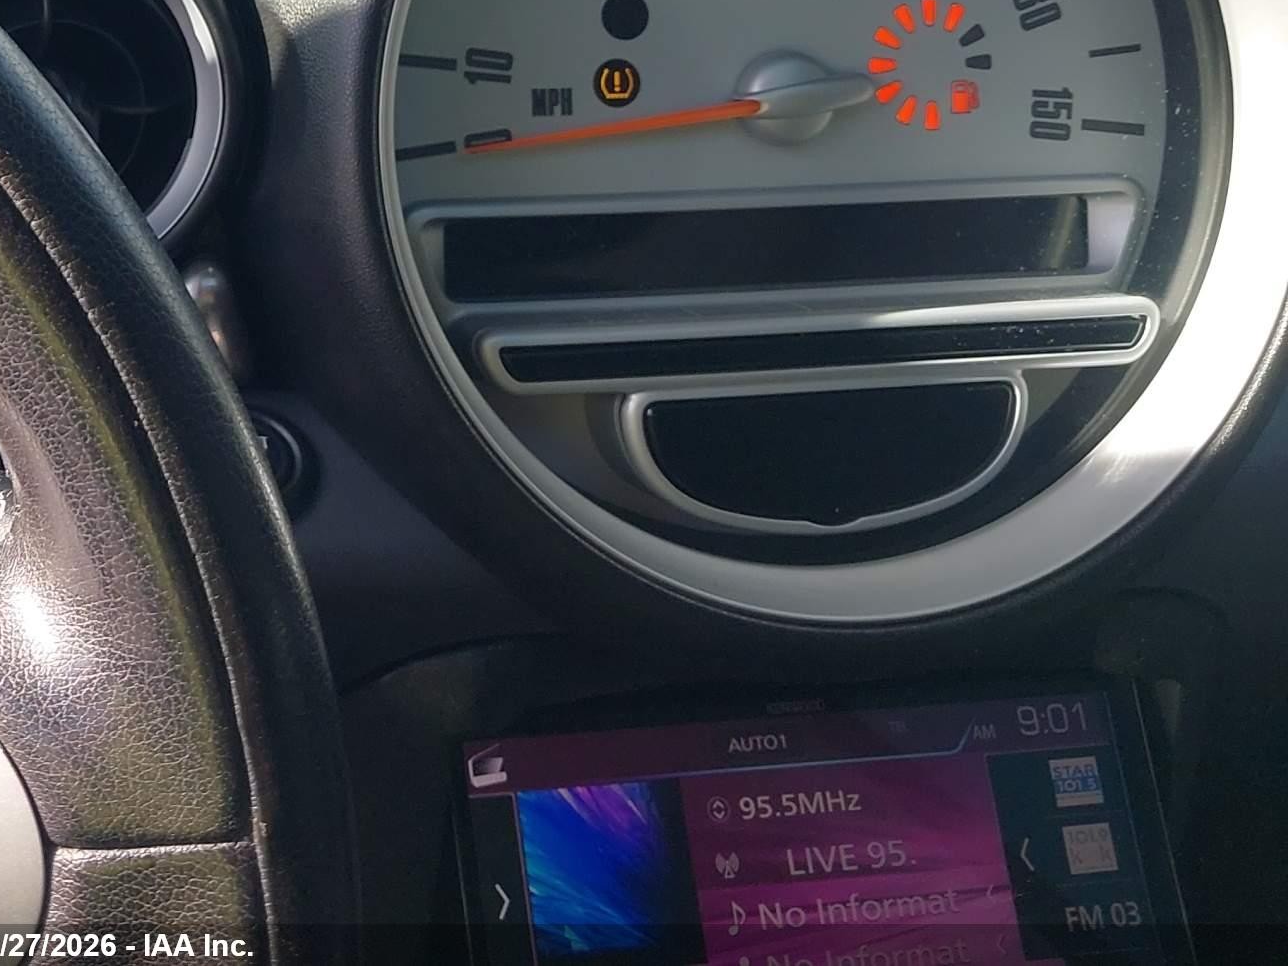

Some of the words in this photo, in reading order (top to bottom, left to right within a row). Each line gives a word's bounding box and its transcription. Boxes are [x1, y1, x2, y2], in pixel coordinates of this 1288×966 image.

[463, 47, 514, 85] 10
[531, 87, 574, 117] MPH
[1029, 87, 1073, 141] 150
[973, 724, 997, 740] AM
[1016, 702, 1088, 736] 9:01
[728, 733, 788, 754] AUTO1
[1052, 764, 1096, 780] STAR
[739, 790, 862, 821] 95.5MHz
[785, 844, 859, 877] LIVE
[866, 839, 917, 870] 95.
[758, 902, 807, 931] No
[817, 888, 963, 925] Informat
[1064, 905, 1105, 932] FM
[1111, 901, 1142, 927] 03
